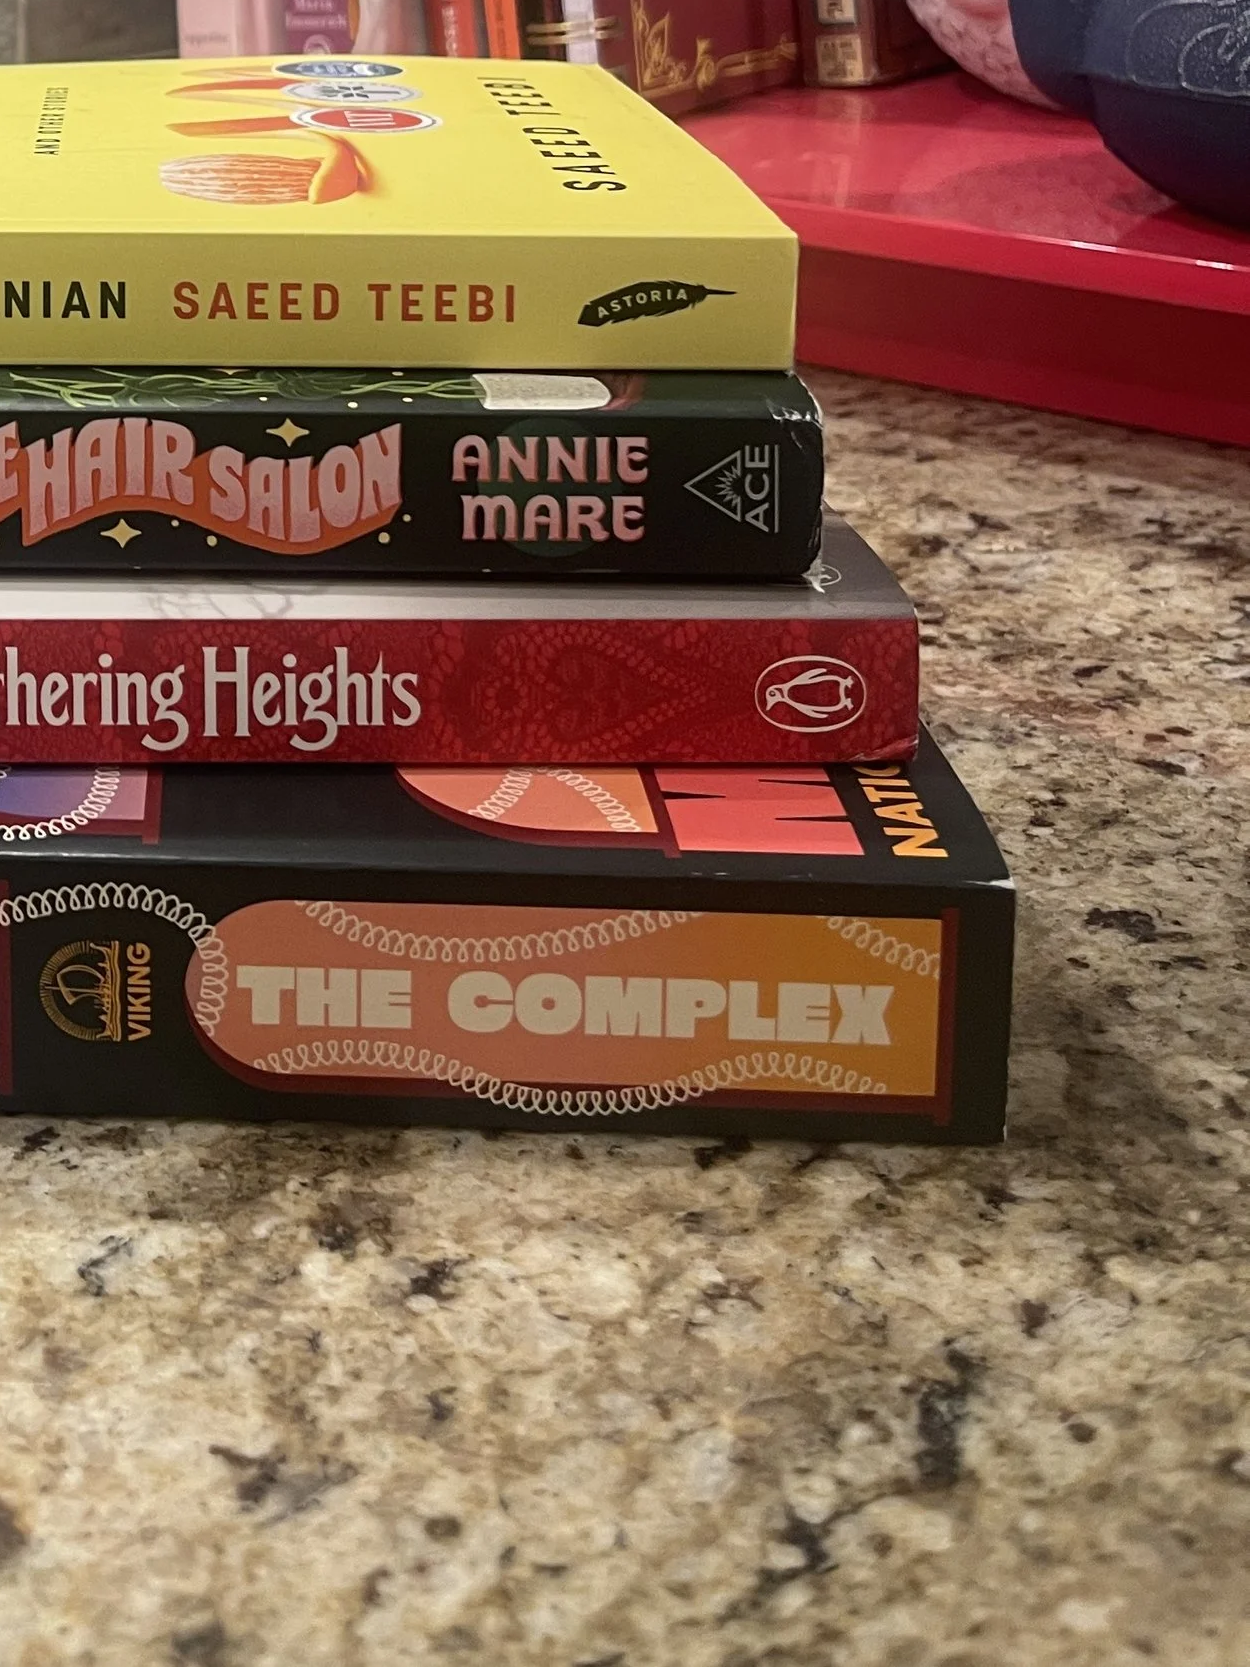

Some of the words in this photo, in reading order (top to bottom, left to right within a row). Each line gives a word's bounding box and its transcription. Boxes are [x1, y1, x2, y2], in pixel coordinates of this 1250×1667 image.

[41, 87, 69, 110] STORIES
[477, 76, 561, 116] TEEBI
[33, 138, 61, 156] AND
[37, 113, 65, 134] OTHER
[522, 127, 627, 192] SAEED
[173, 280, 340, 320] SAEED
[367, 283, 515, 322] TEEBI
[596, 287, 690, 320] ASTORIA
[26, 417, 196, 536] HAIR
[208, 423, 402, 543] SALON
[451, 434, 649, 484] ANNIE
[744, 444, 770, 533] ACE
[460, 494, 646, 543] MARE
[202, 646, 422, 752] Heights
[128, 942, 153, 1042] VIKING
[236, 966, 412, 1028] THE
[447, 971, 894, 1045] COMPLEX
